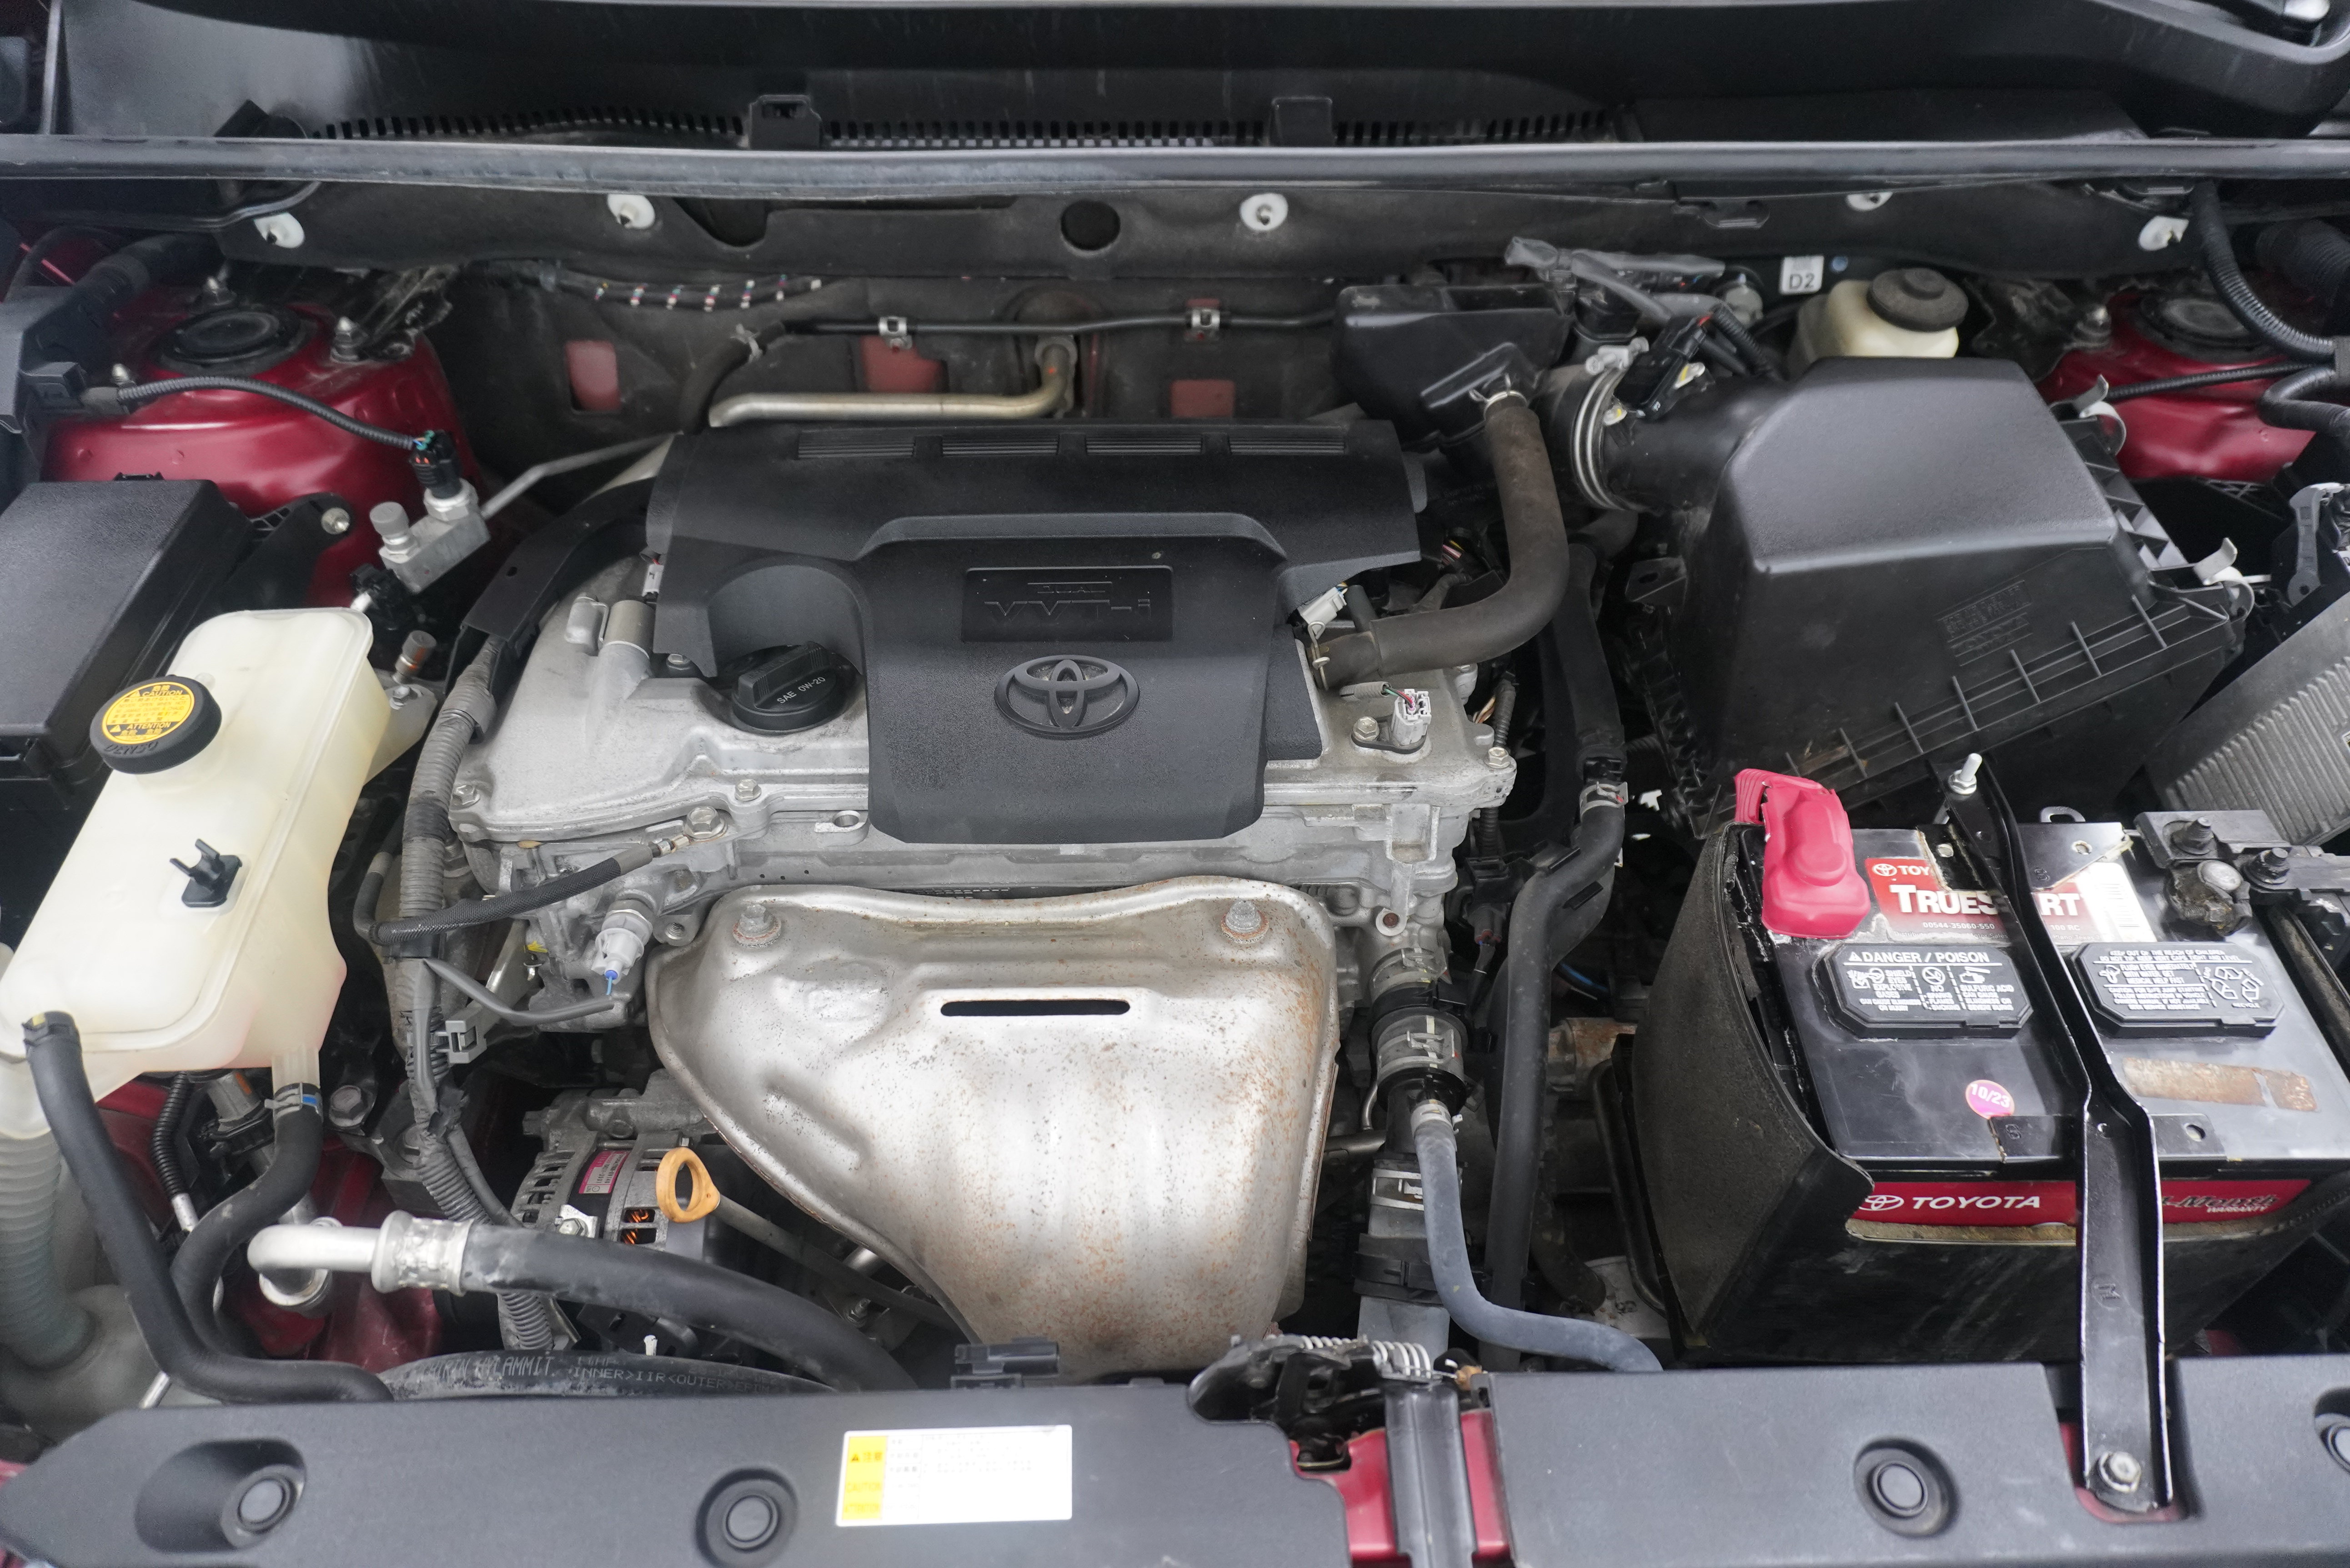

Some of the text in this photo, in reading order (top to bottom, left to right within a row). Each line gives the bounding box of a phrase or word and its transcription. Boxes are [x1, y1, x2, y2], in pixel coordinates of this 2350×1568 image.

[1789, 273, 1815, 289] D2
[984, 599, 1151, 626] VVT-i
[777, 677, 826, 704] SAE 0W-20
[104, 742, 159, 755] DENSO
[1898, 865, 1934, 876] TOY
[1923, 921, 1995, 930] 00544-35060-550
[1862, 952, 1990, 963] DANGER / POISON
[1885, 970, 1913, 978] SHIELD
[1873, 984, 1913, 992] EXPLOSIVE
[1970, 1083, 2011, 1108] 10/23
[1912, 1196, 2040, 1209] TOYOTA
[846, 1481, 883, 1493] CAUTION
[844, 1503, 882, 1514] ATTENTION
